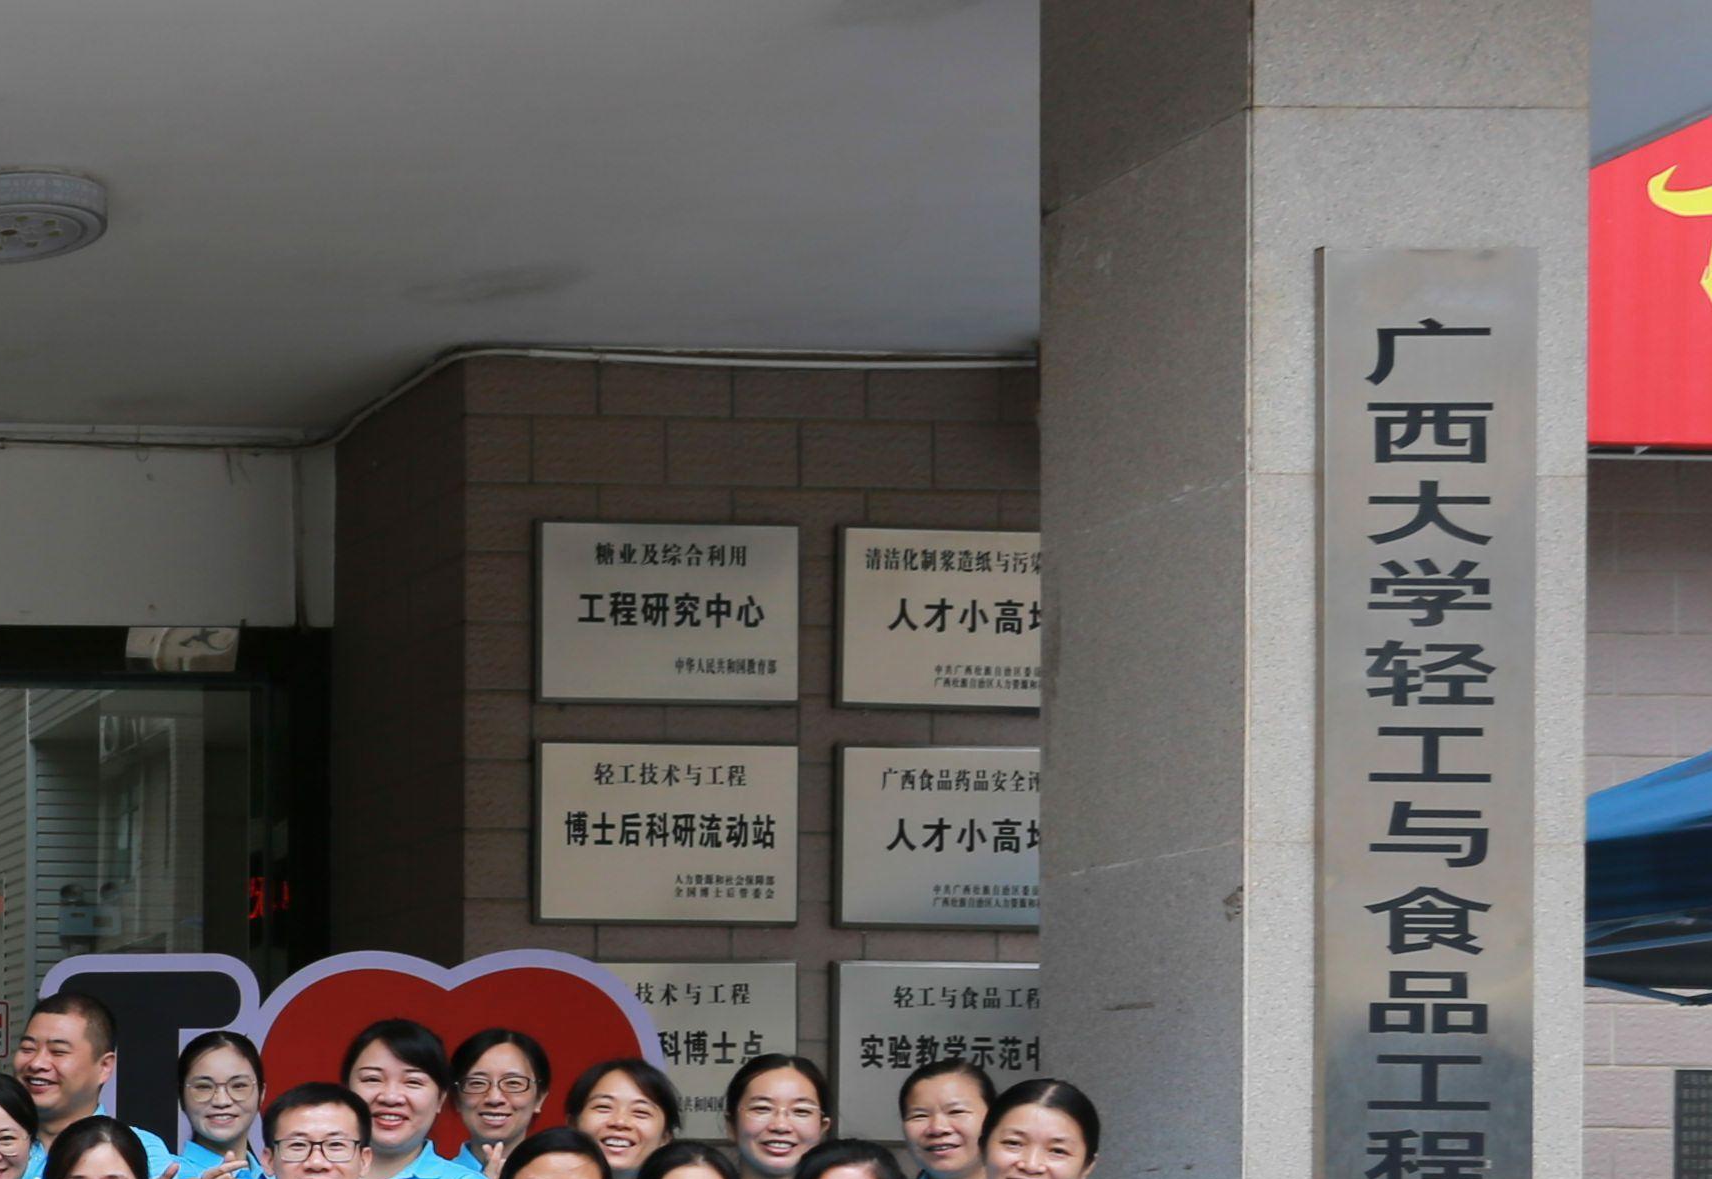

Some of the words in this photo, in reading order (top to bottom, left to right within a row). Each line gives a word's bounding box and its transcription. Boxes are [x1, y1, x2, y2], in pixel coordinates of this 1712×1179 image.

[595, 542, 748, 567] 糖业及综合利用
[578, 592, 765, 628] 工程研究中心
[675, 657, 777, 675] 中华人民共和国教育部
[594, 762, 748, 786] 轻工技术与工程
[565, 811, 776, 849] 博士后科研流动站
[675, 874, 774, 886] 人力资源和社会保障部
[675, 887, 774, 899] 全国博士后管委会
[635, 982, 751, 1006] 技术与工程
